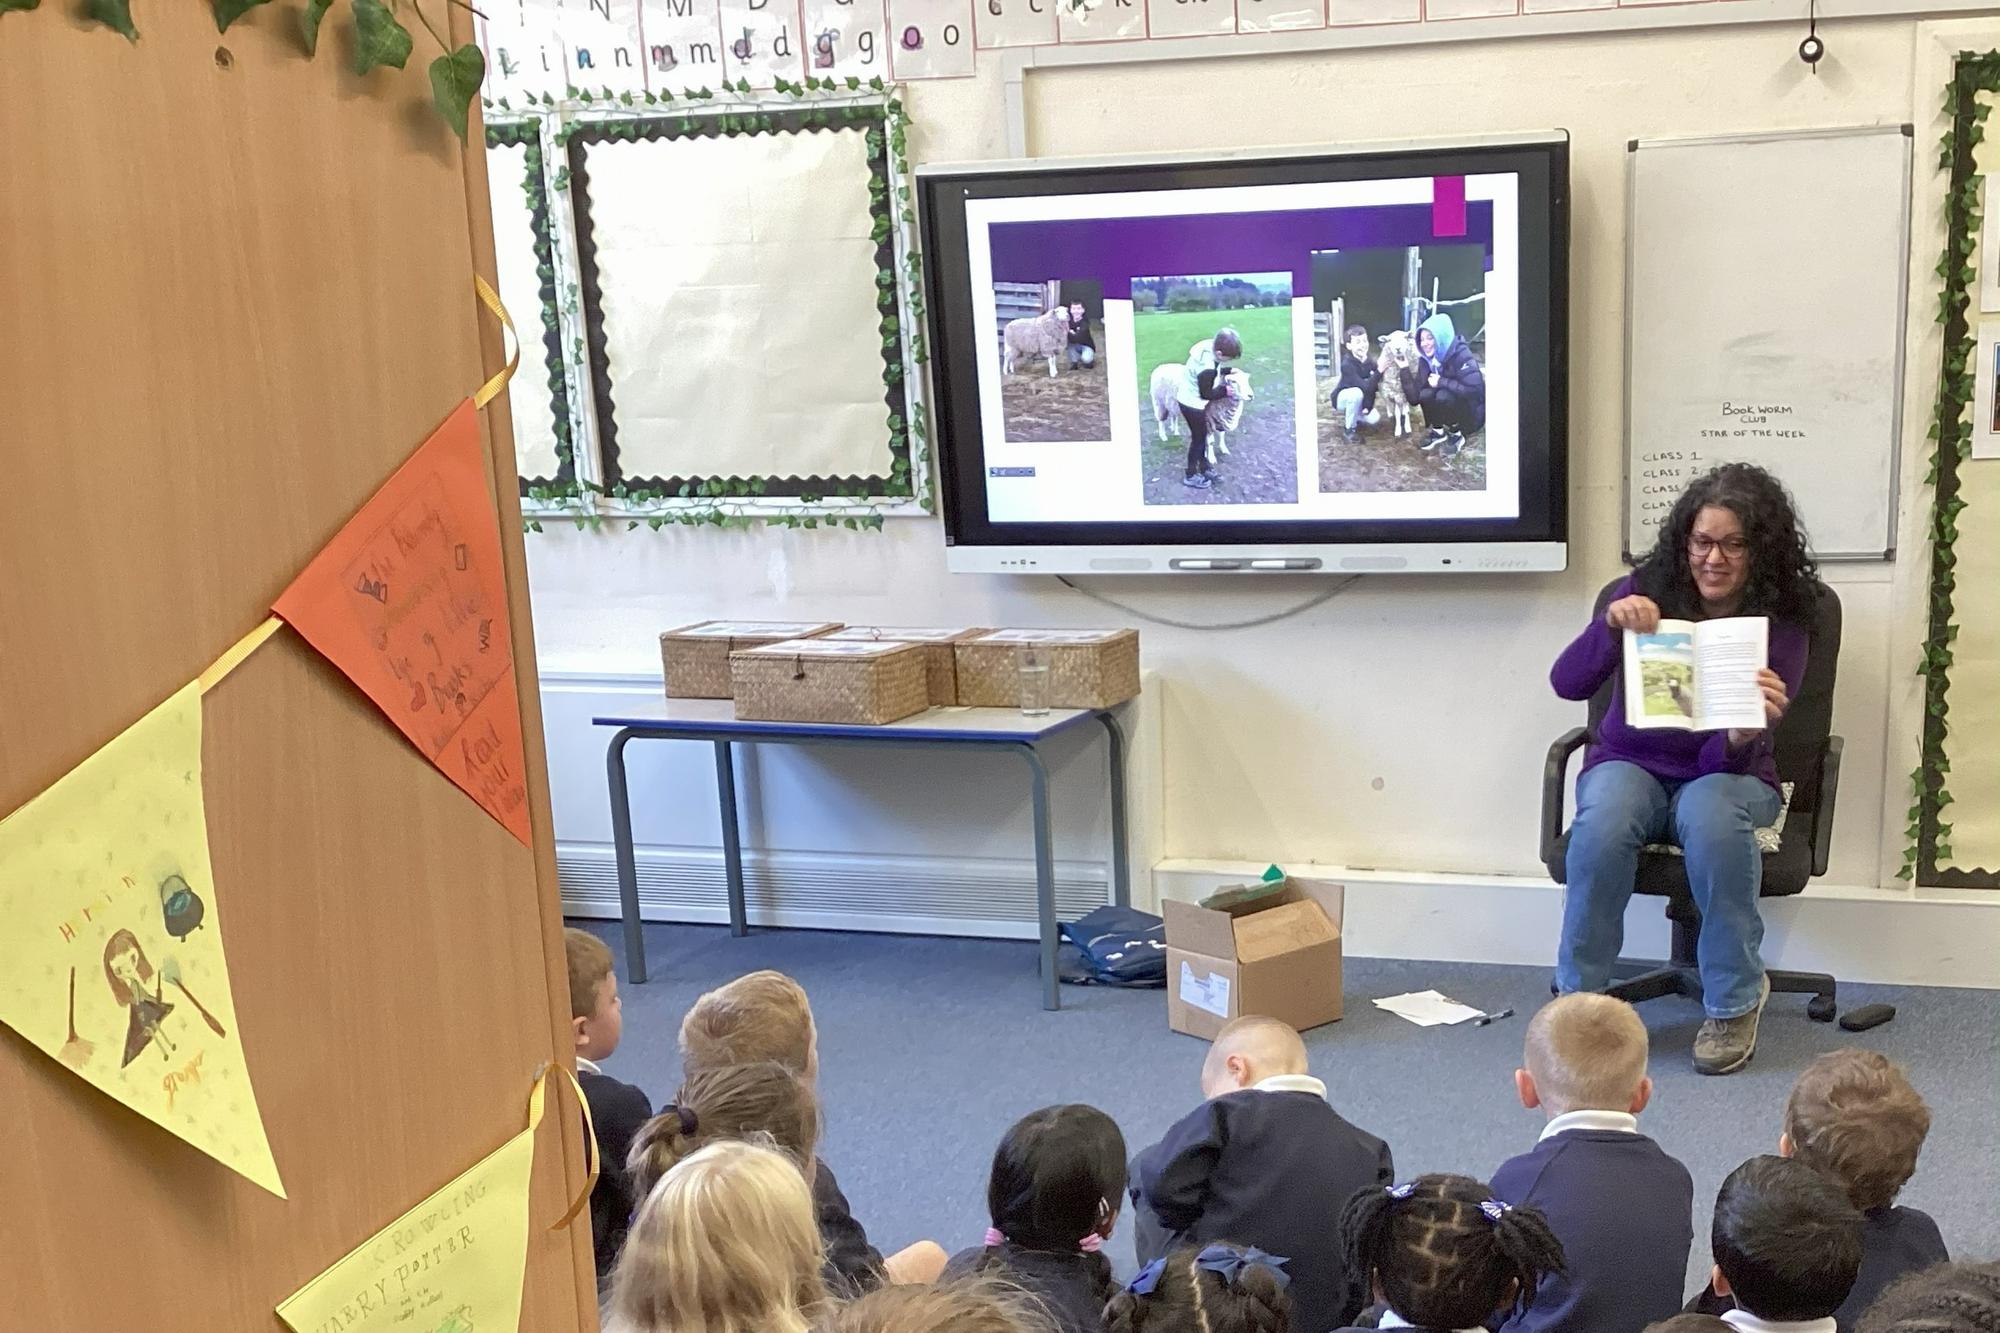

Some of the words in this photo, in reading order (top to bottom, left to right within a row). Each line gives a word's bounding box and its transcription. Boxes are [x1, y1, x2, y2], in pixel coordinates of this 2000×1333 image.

[773, 25, 791, 57] d
[943, 24, 960, 46] o
[540, 45, 550, 72] i
[613, 46, 632, 68] n
[689, 42, 716, 64] m
[858, 31, 874, 64] g
[1740, 415, 1767, 424] CLUB
[1700, 429, 1729, 438] STAR
[1751, 429, 1773, 437] THE
[1776, 430, 1806, 438] WEEK
[1642, 451, 1683, 462] CLASS
[1690, 451, 1703, 460] 1
[1643, 469, 1681, 478] CLASS
[1642, 484, 1681, 494] CLASS
[1642, 500, 1675, 510] CLAS
[316, 1281, 388, 1333] ARRY
[394, 1225, 476, 1292] POTTER
